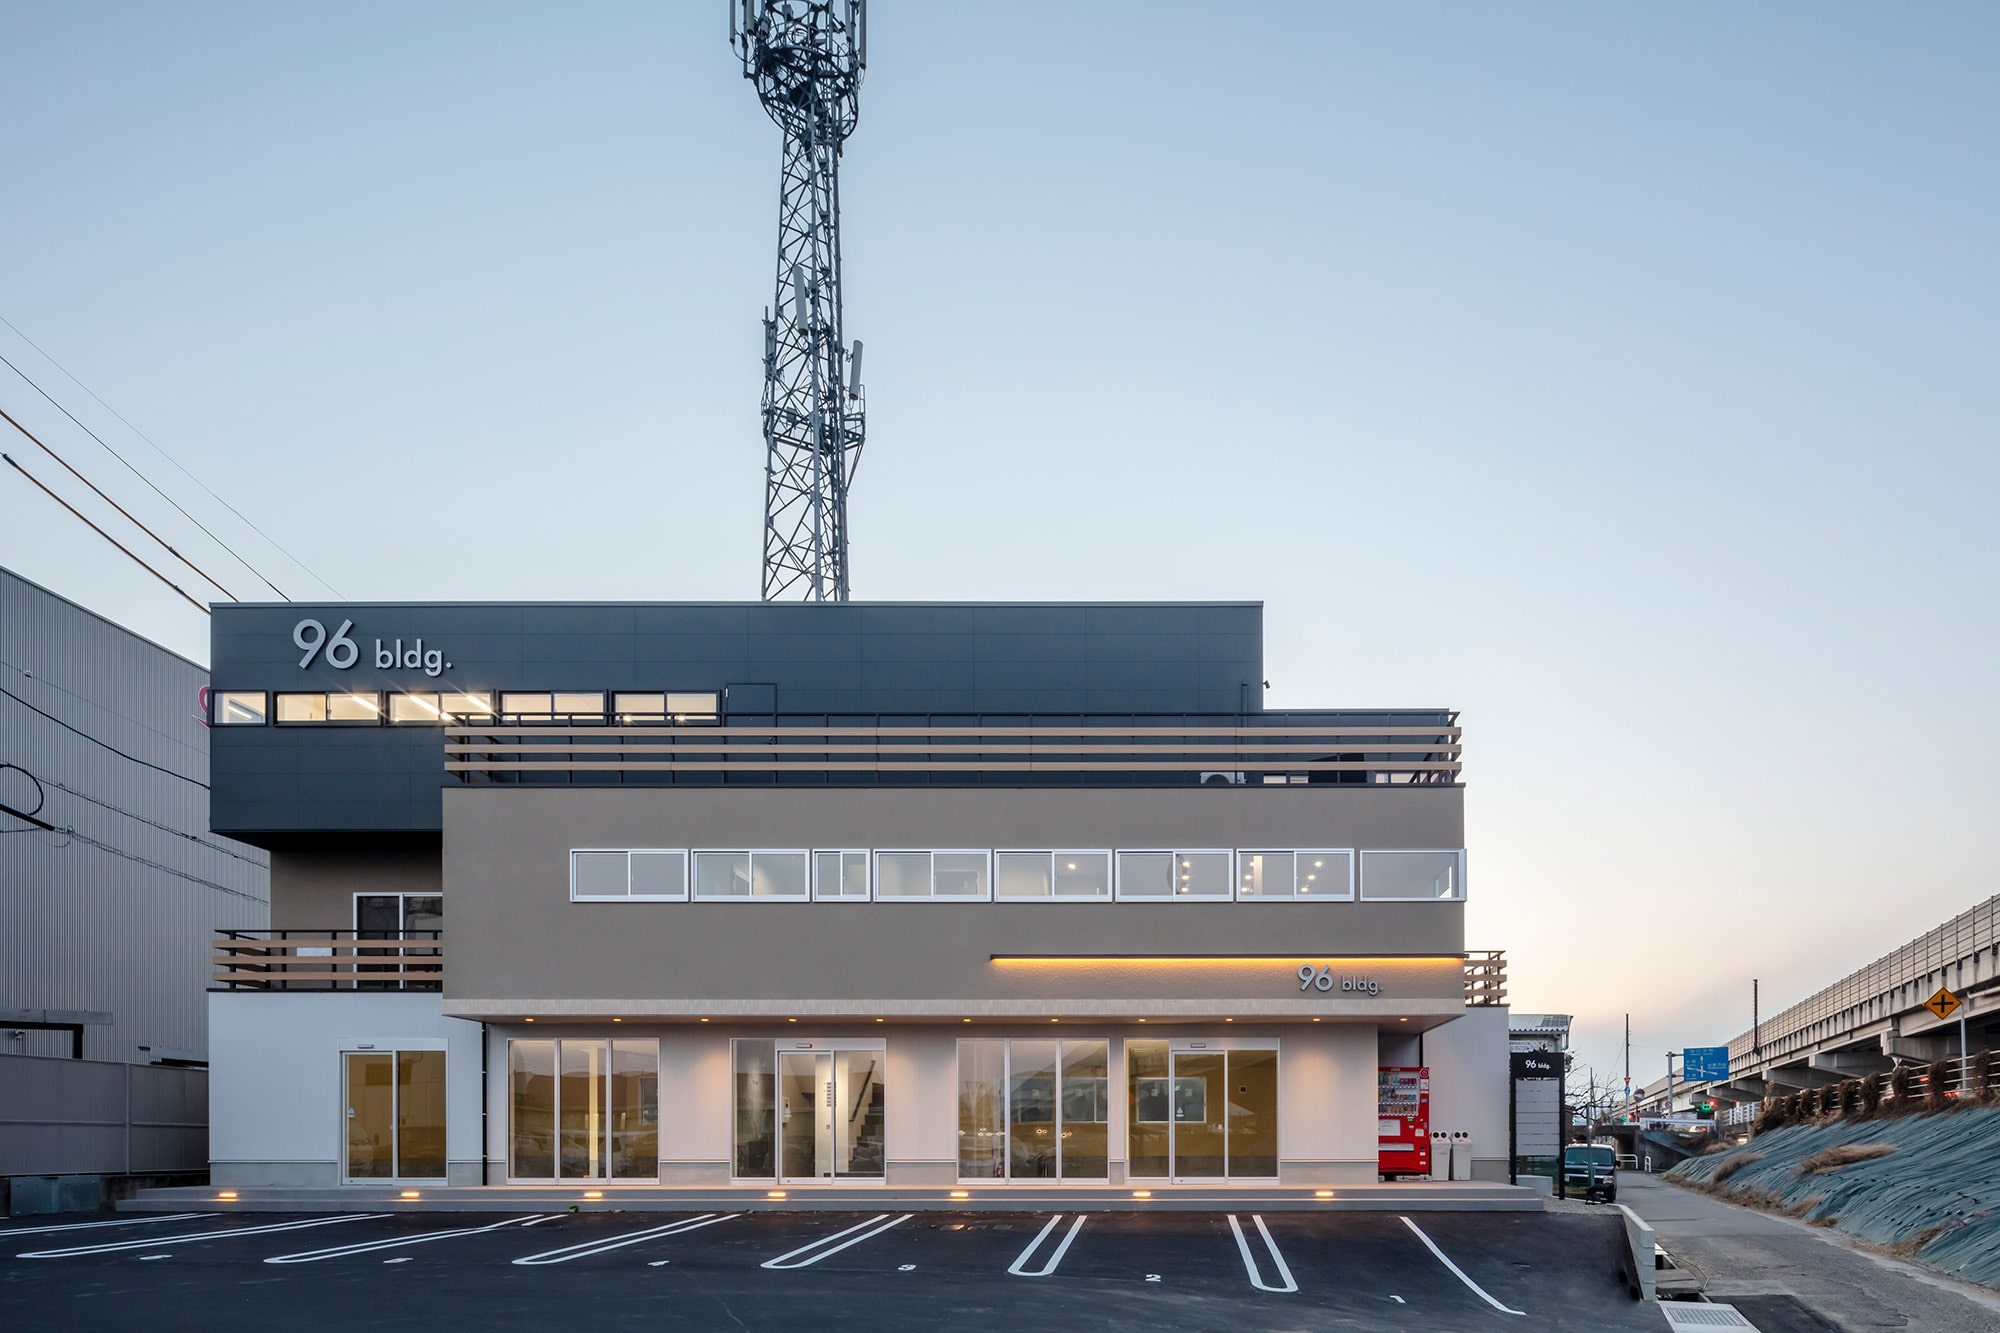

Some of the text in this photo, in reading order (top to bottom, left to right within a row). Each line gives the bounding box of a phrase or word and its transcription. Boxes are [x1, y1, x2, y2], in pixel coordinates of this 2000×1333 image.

[293, 618, 453, 677] 96 bldg.
[1297, 963, 1383, 996] 96 bldg.
[1525, 1059, 1537, 1069] 96
[1145, 1274, 1162, 1282] 2
[1389, 1295, 1406, 1304] 1
